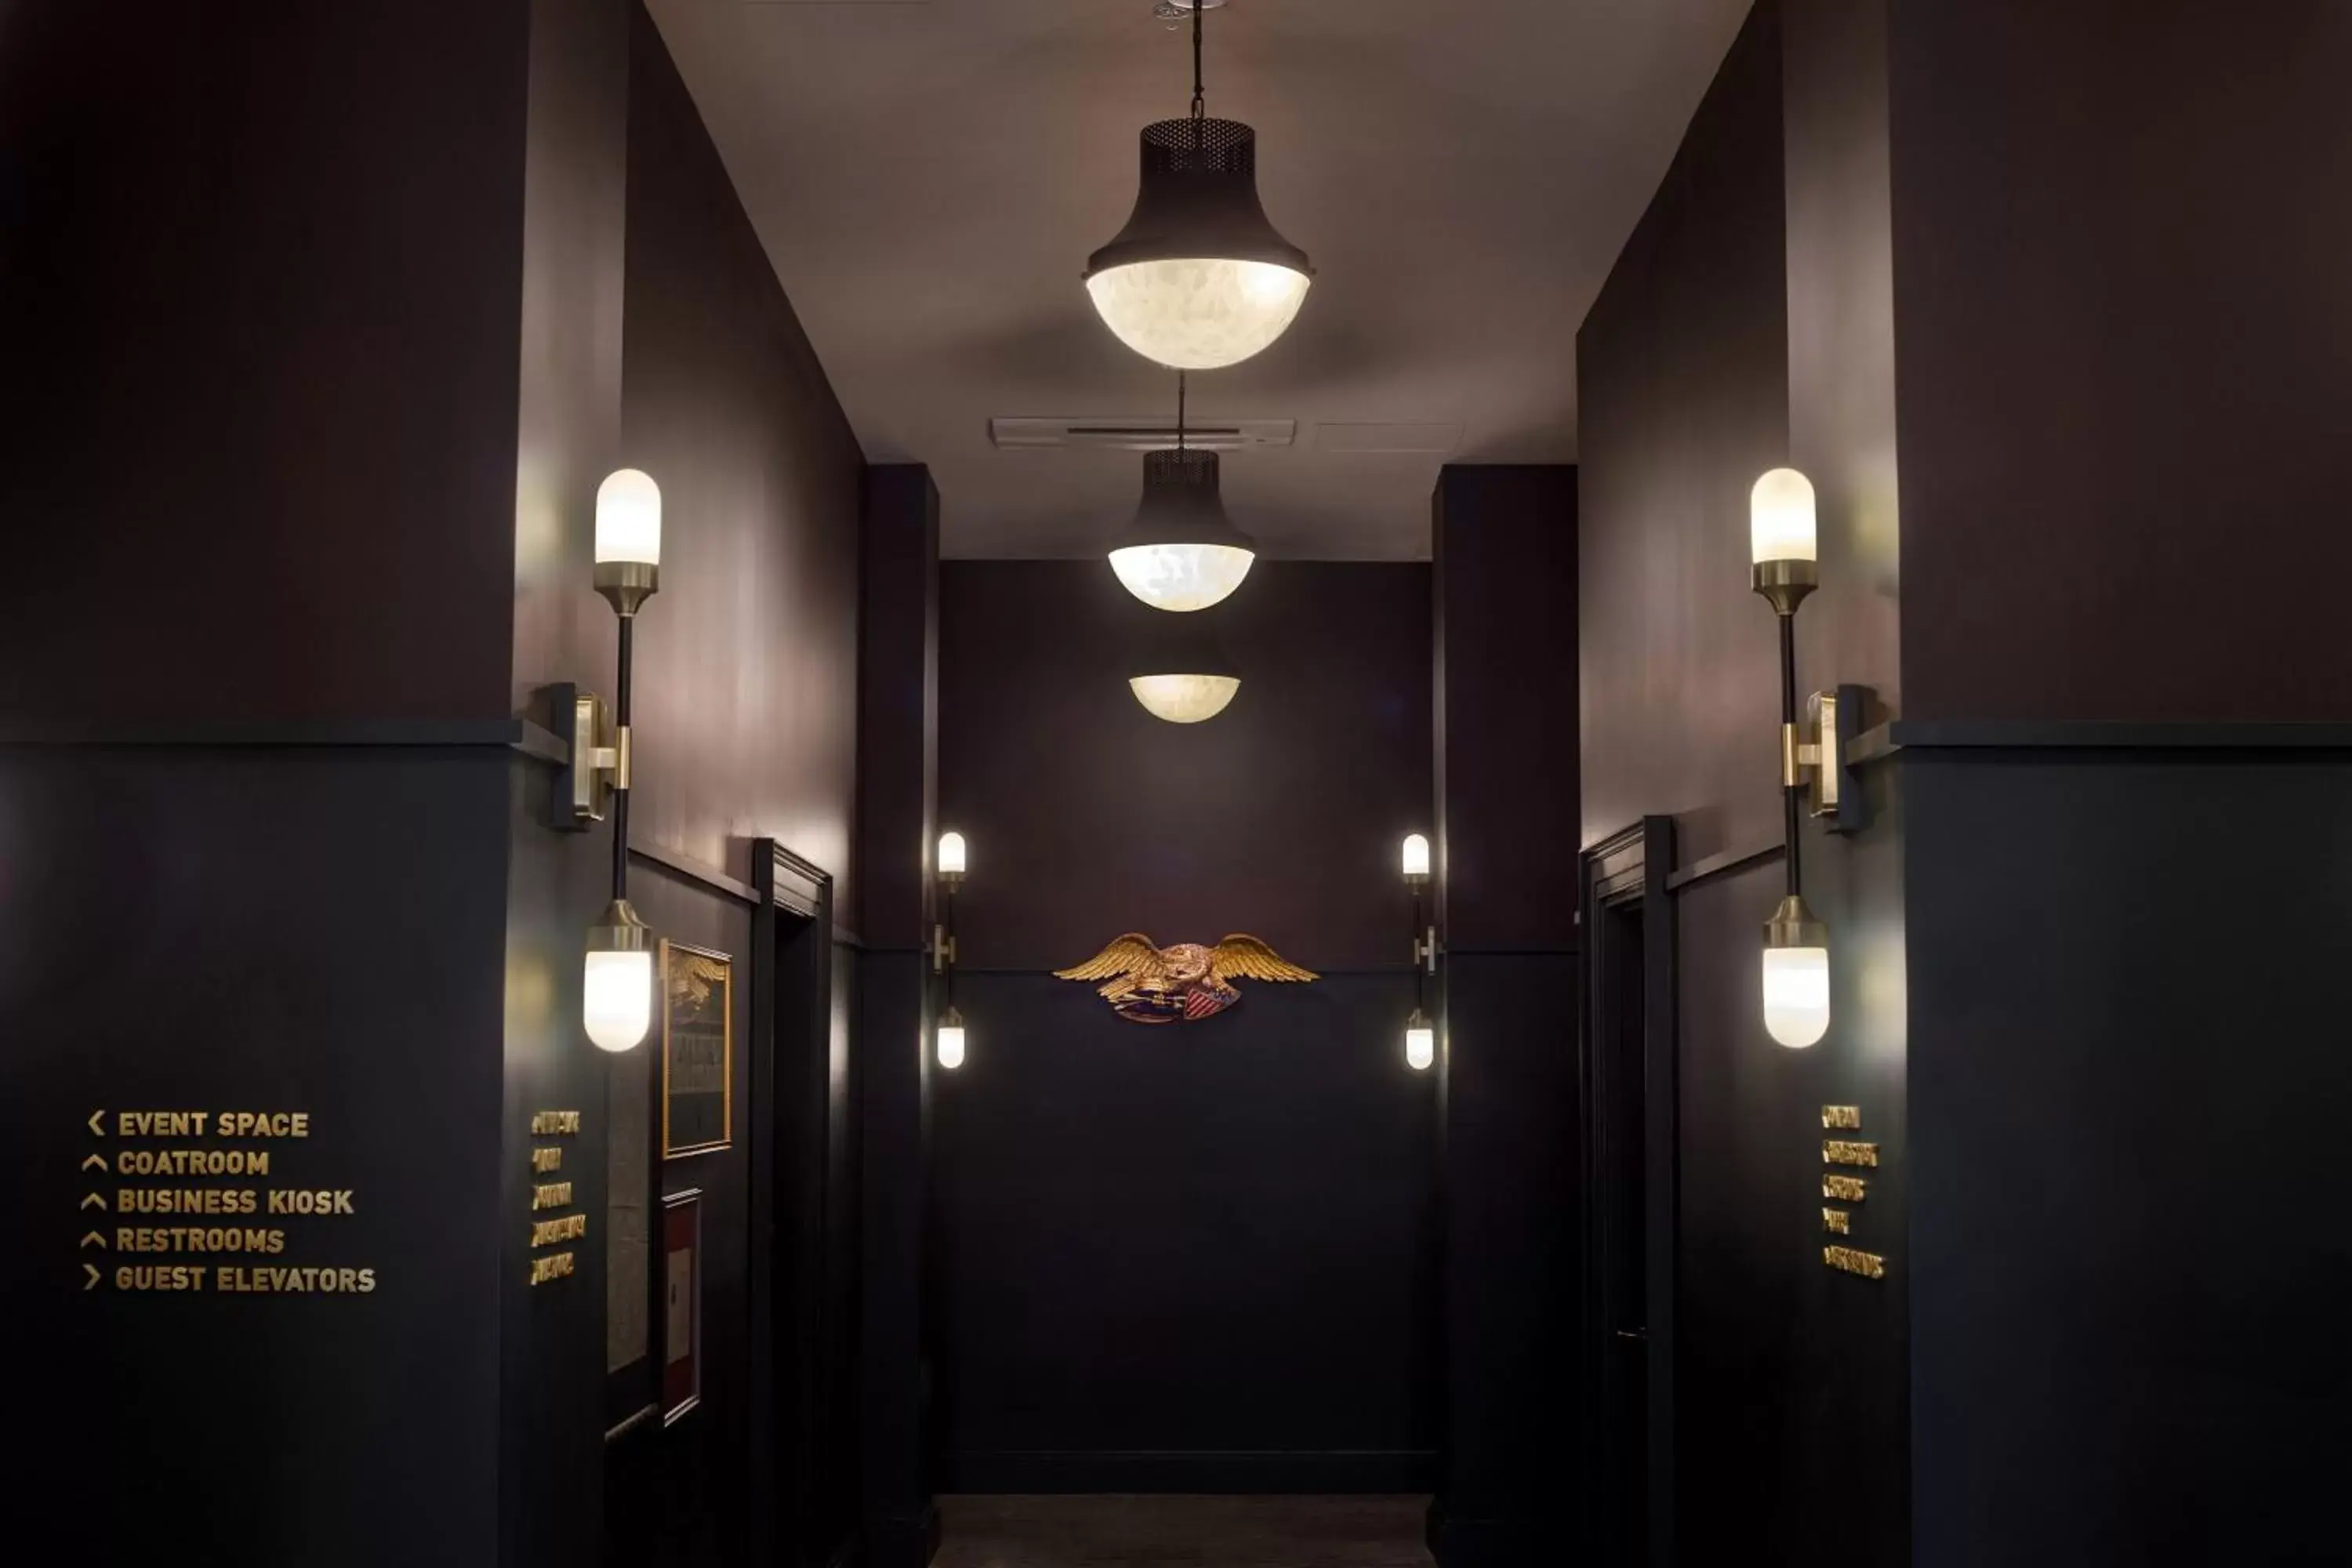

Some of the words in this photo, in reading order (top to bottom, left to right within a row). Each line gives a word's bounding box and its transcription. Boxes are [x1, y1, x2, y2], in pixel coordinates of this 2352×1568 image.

[118, 1112, 209, 1136] EVENT
[217, 1112, 309, 1138] SPACE
[118, 1151, 269, 1175] COATROOM
[118, 1190, 256, 1214] BUSINESS
[268, 1190, 354, 1214] KIOSK
[117, 1229, 285, 1253] RESTROOMS
[116, 1267, 205, 1290] GUEST
[217, 1267, 376, 1292] ELEVATORS
